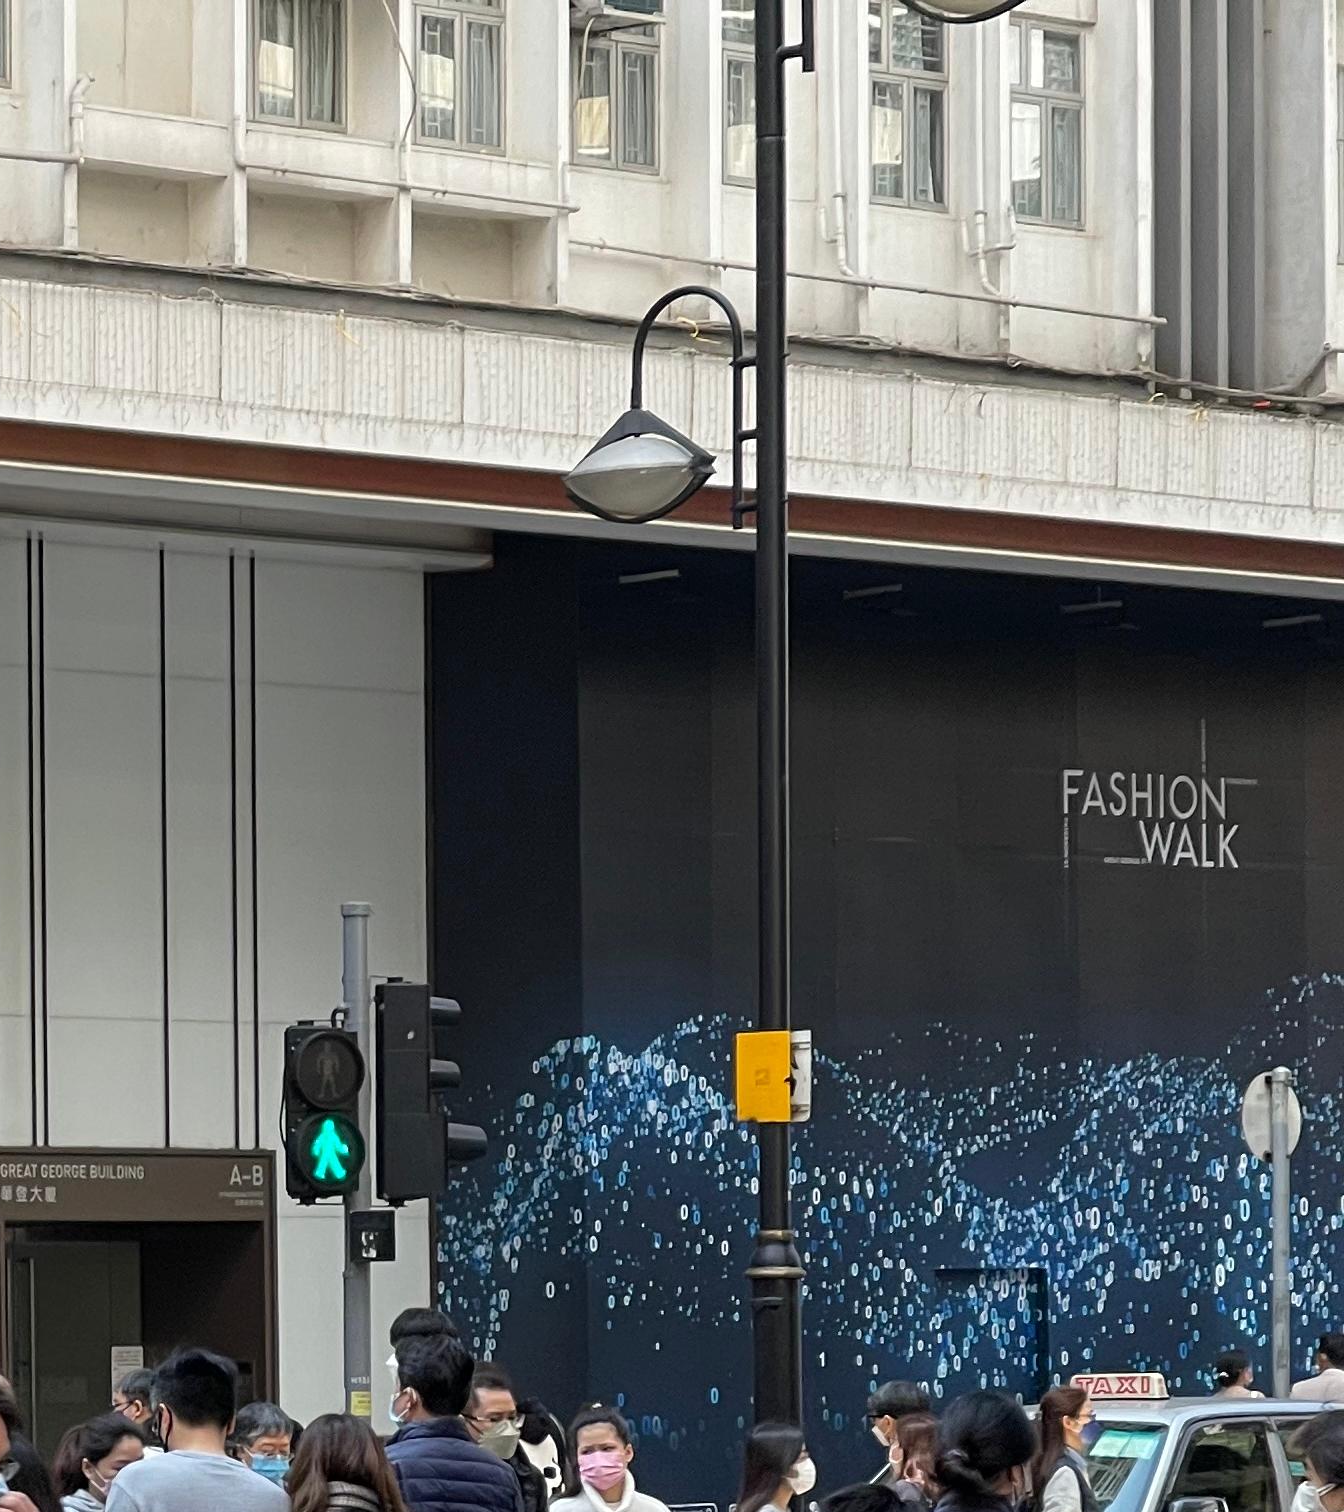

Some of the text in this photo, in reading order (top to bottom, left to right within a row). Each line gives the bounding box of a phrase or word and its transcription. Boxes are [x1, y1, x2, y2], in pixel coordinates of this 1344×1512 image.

[1063, 769, 1226, 820] FASHION
[1139, 820, 1239, 868] WALK
[0, 1163, 264, 1186] GREAT GEORGE BUILDING A-B
[1075, 1376, 1151, 1394] TAXI
